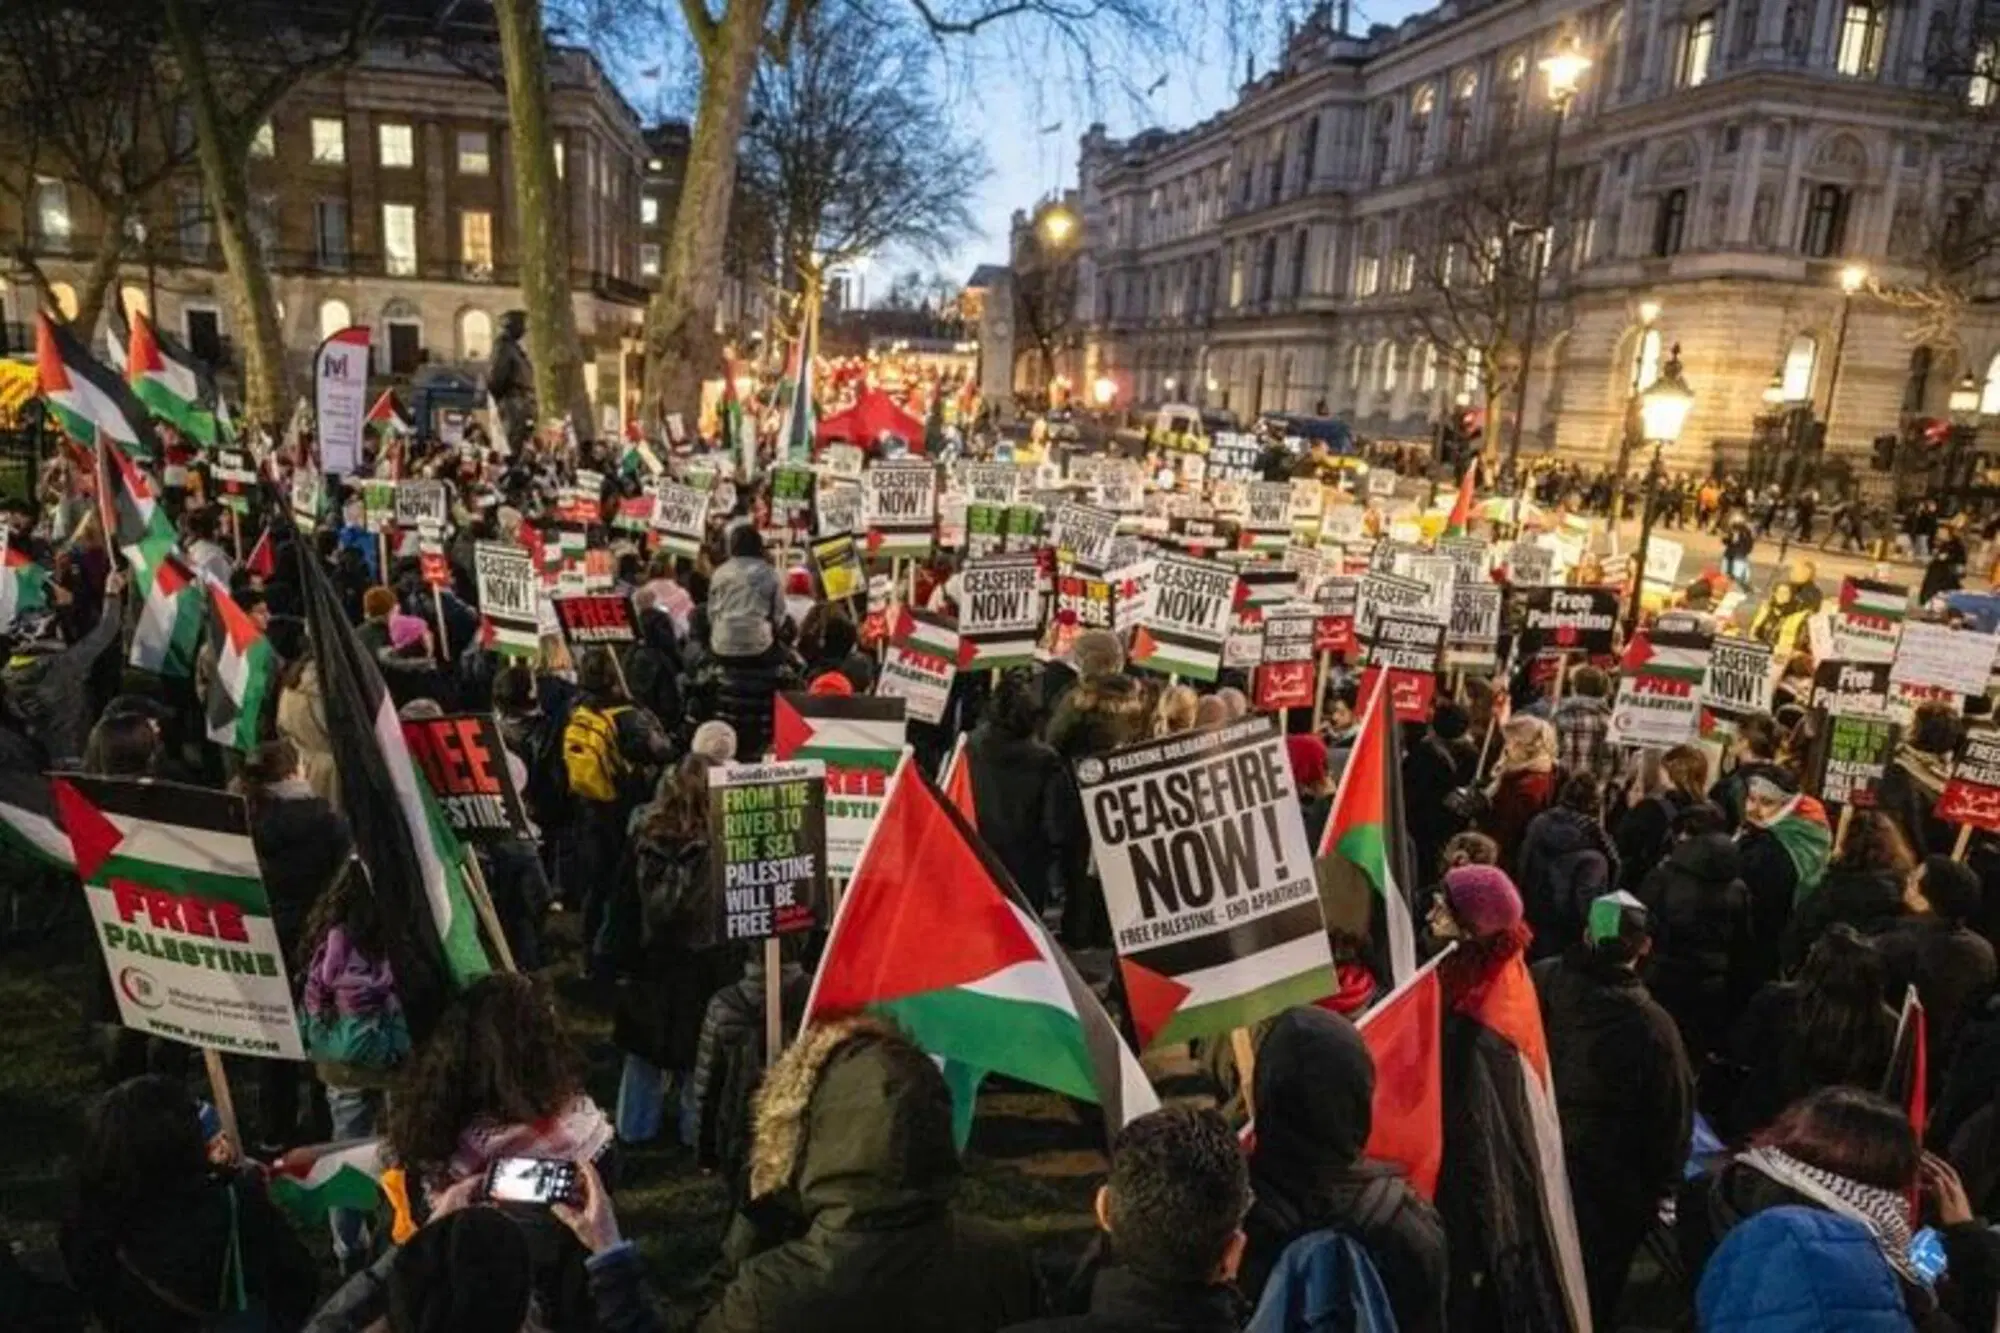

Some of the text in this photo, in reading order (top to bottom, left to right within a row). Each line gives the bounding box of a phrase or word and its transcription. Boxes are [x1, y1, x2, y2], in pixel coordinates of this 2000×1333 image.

[872, 471, 931, 489] CEASEFIRE
[879, 490, 927, 514] NOW!
[964, 569, 1036, 592] CEASEFIRE
[1153, 563, 1233, 598] CEASEFIRE
[562, 599, 627, 628] FREE
[971, 592, 1030, 622] NOW!
[1155, 587, 1222, 629] NOW!
[1551, 591, 1593, 610] Free
[1711, 669, 1762, 706] NOW!
[402, 718, 502, 794] REE
[723, 780, 808, 812] FROM THE
[1094, 745, 1288, 846] CEASEFIRE
[725, 807, 801, 837] RIVER TO
[725, 833, 795, 862] THE SEA
[1128, 805, 1288, 920] NOW!
[725, 854, 815, 888] PALESTINE
[111, 879, 249, 943] FREE
[726, 880, 796, 913] WILL BE
[1120, 924, 1152, 948] FREE
[1153, 909, 1218, 940] PALESTINE
[1226, 900, 1250, 922] END
[1252, 878, 1312, 916] APARTHEID
[727, 911, 773, 939] FREE
[103, 922, 279, 977] PALESTINE
